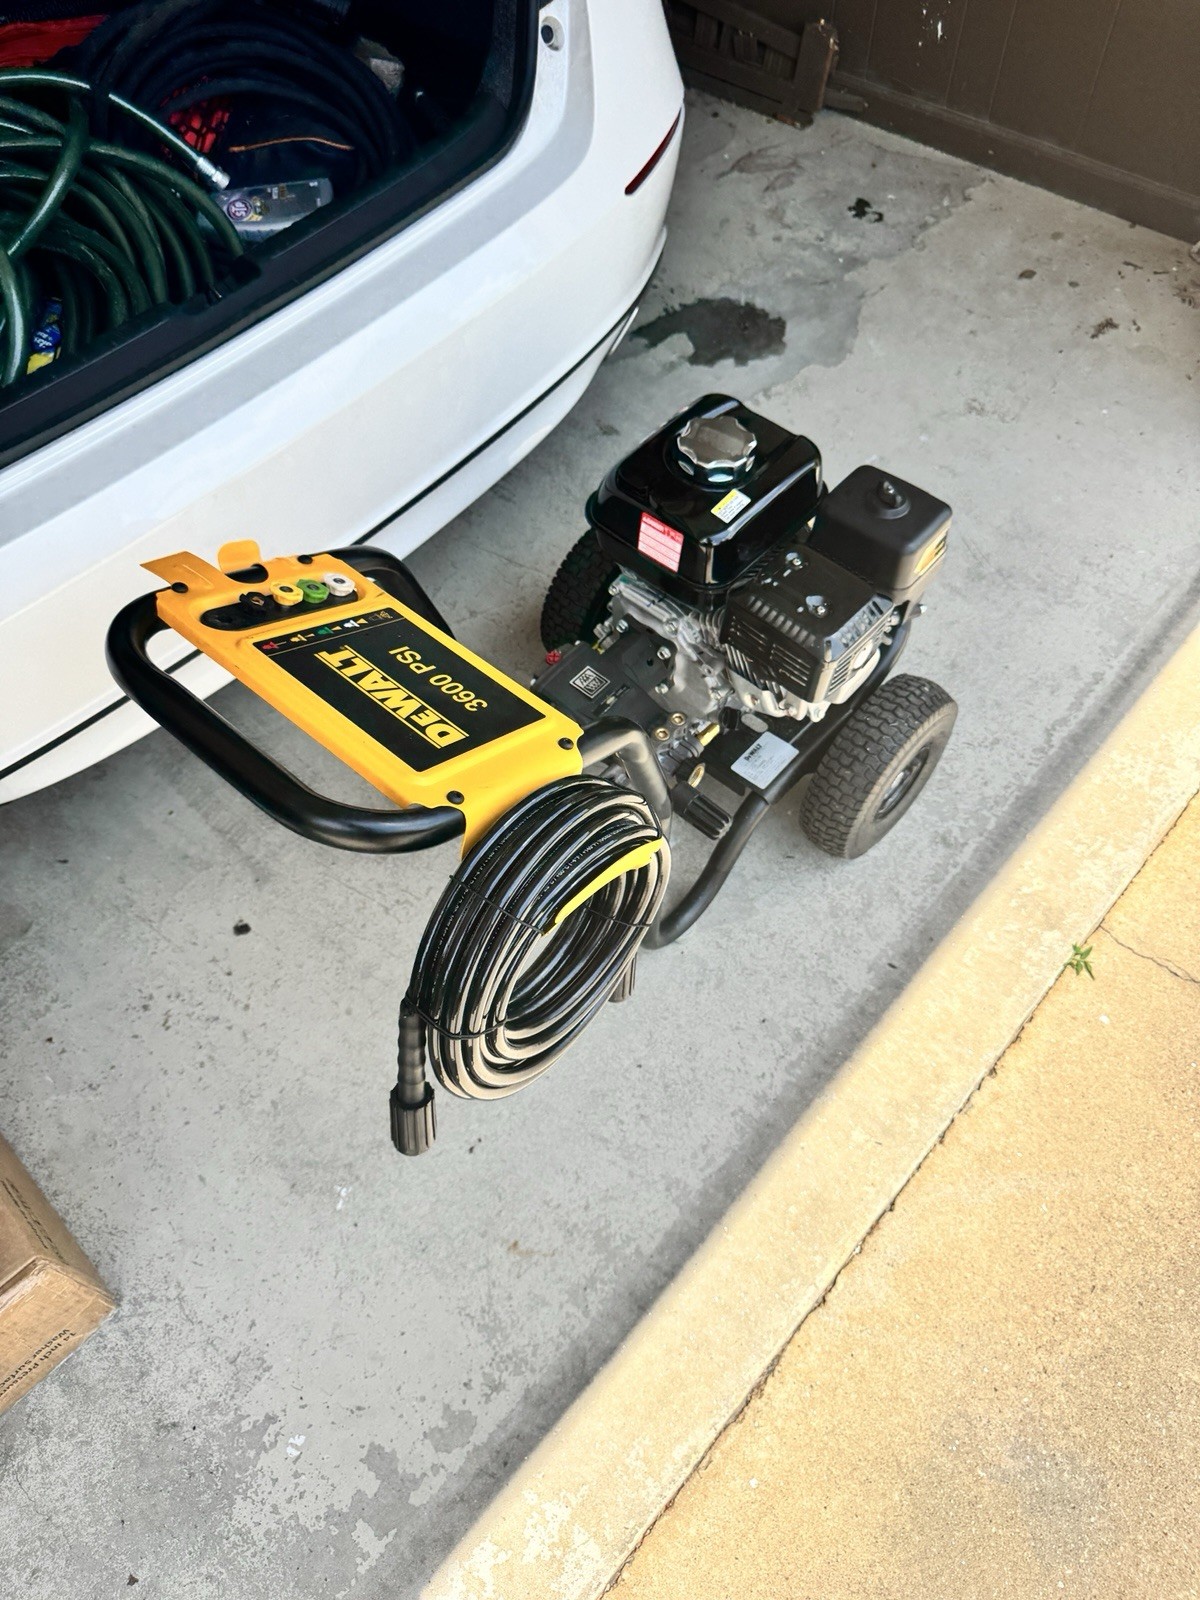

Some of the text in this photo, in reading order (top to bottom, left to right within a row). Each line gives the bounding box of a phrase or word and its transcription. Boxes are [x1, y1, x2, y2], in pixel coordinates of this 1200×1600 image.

[230, 201, 247, 217] STP
[388, 646, 488, 712] 3600 PSI
[315, 645, 469, 749] DEWALT
[32, 1329, 70, 1359] Washer
[63, 1332, 77, 1342] 14
[40, 1342, 62, 1361] Inch
